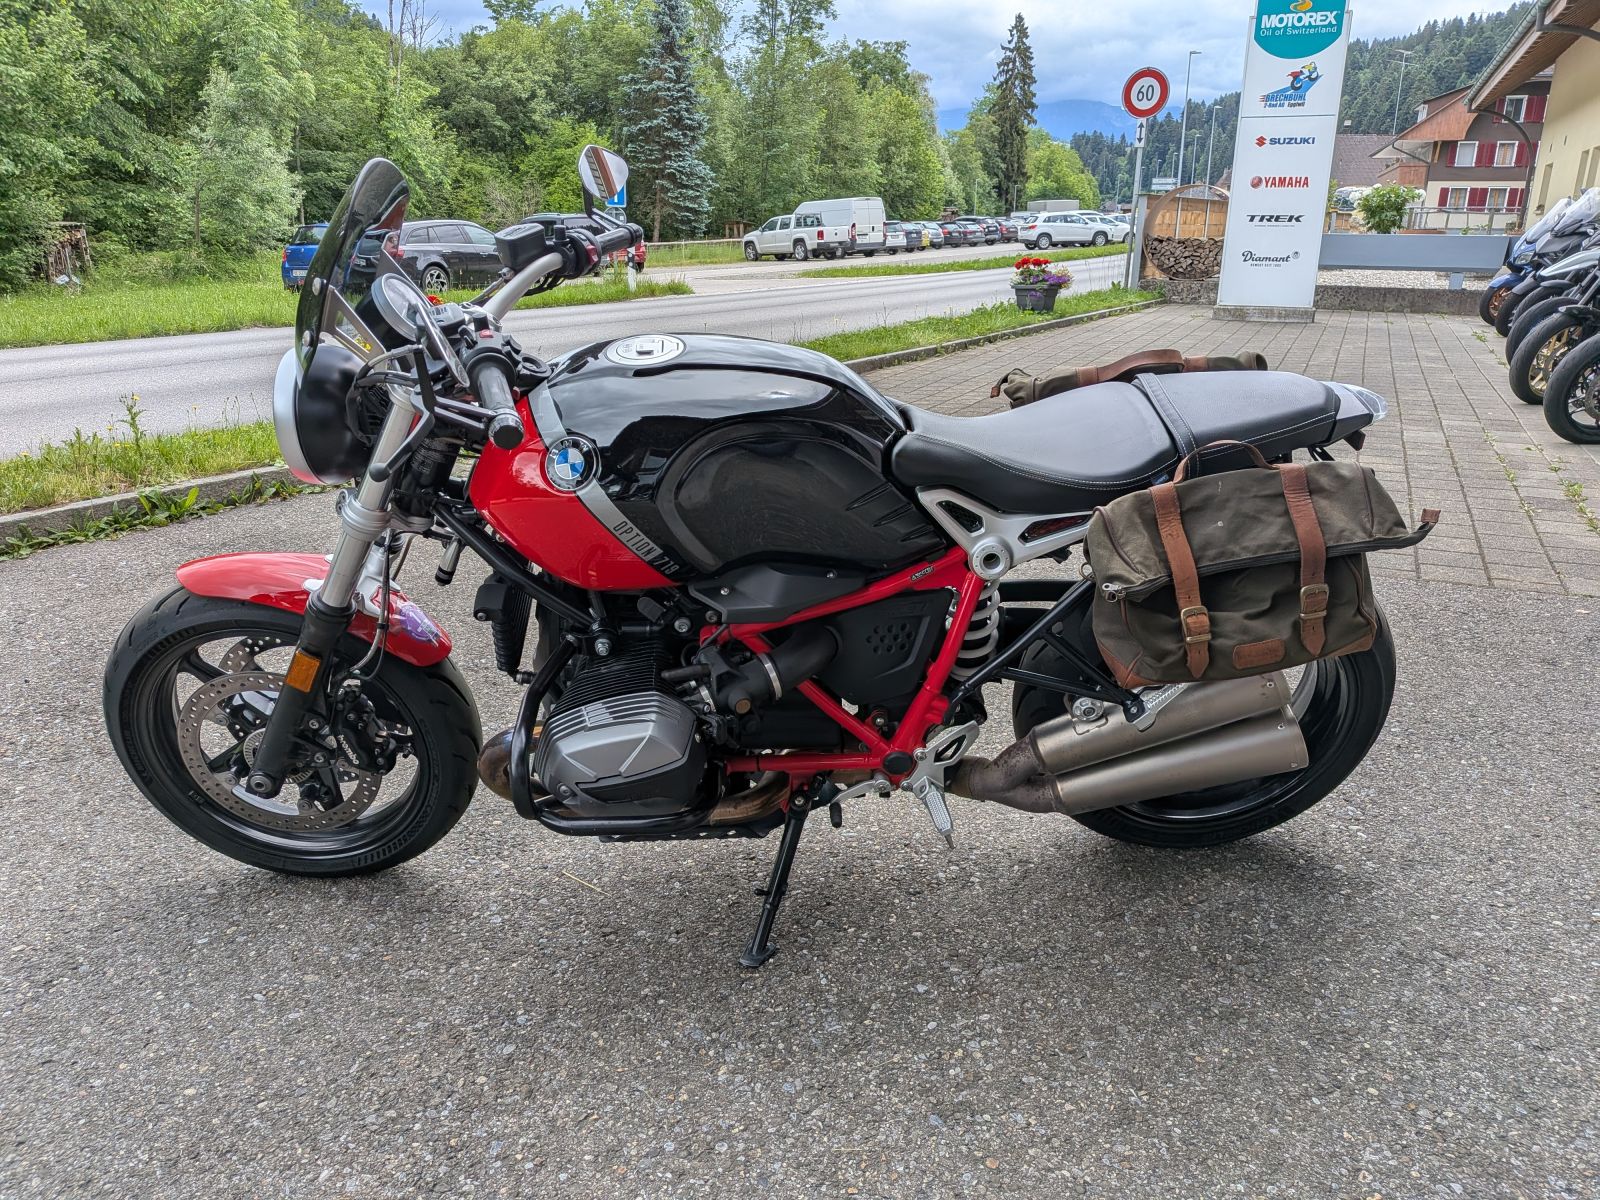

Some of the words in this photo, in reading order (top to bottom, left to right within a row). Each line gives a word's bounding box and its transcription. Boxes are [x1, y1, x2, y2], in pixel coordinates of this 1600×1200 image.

[1261, 11, 1337, 28] MOTOREX
[1260, 28, 1272, 37] Oil
[1274, 28, 1284, 36] of
[1286, 26, 1337, 36] Switzerland
[1136, 84, 1155, 102] 60
[1269, 137, 1315, 145] SUZUKI
[1264, 176, 1309, 188] YAMAHA
[1246, 214, 1305, 223] TREK
[1241, 250, 1291, 263] Diamant
[613, 520, 657, 558] OPTION
[653, 555, 680, 575] 719
